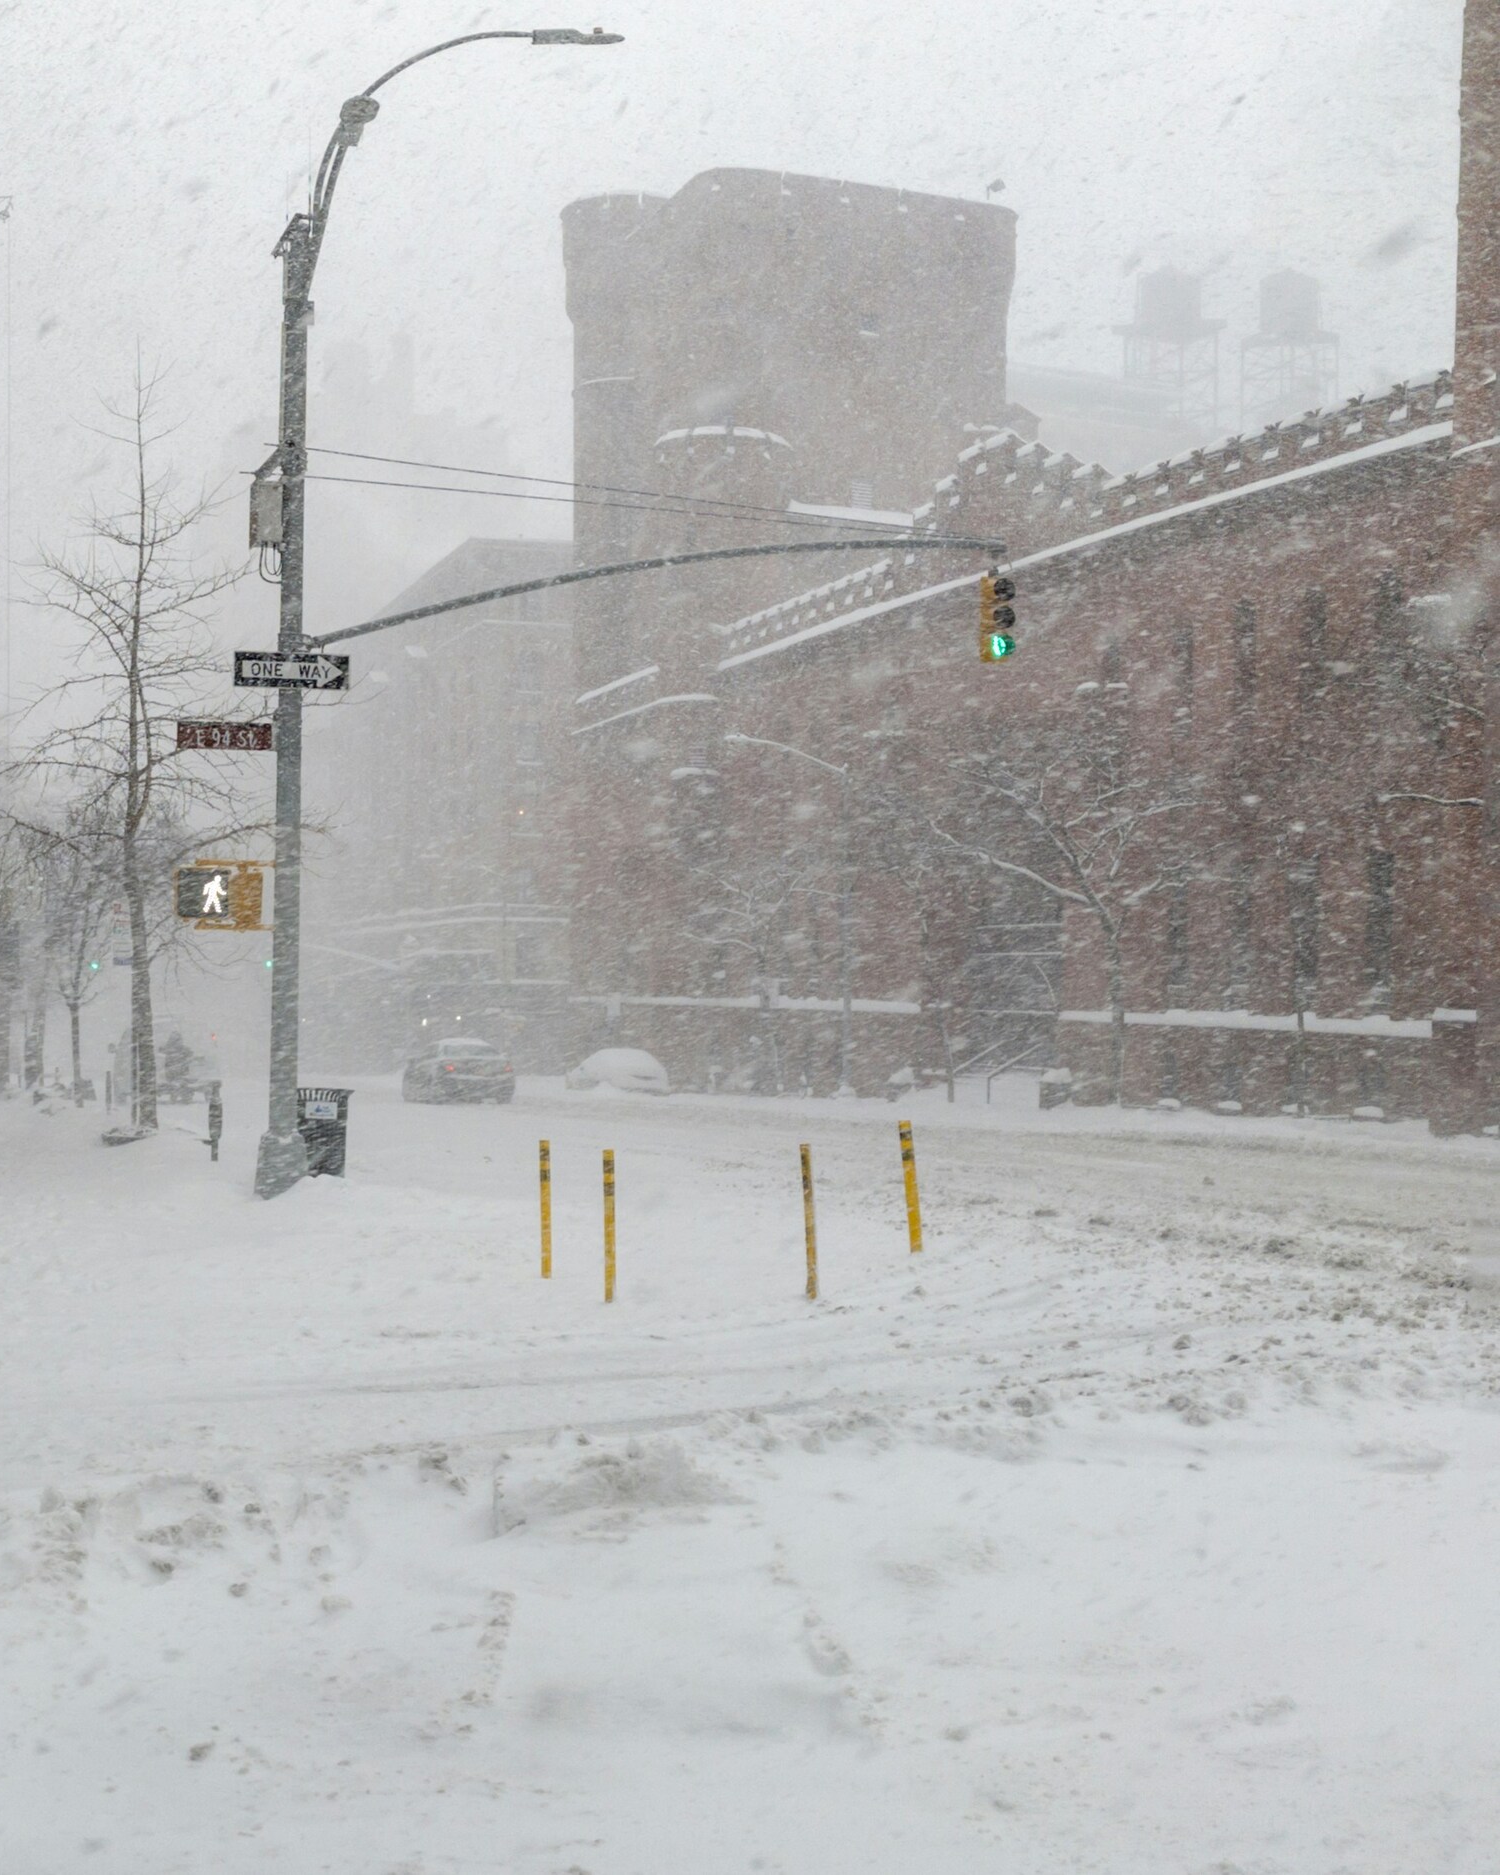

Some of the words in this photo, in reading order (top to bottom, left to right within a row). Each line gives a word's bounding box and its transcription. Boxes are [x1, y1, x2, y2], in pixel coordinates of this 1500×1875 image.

[251, 662, 283, 676] ONE
[299, 665, 331, 679] WAY
[195, 729, 206, 747] E
[212, 728, 230, 747] 94
[236, 729, 257, 748] St
